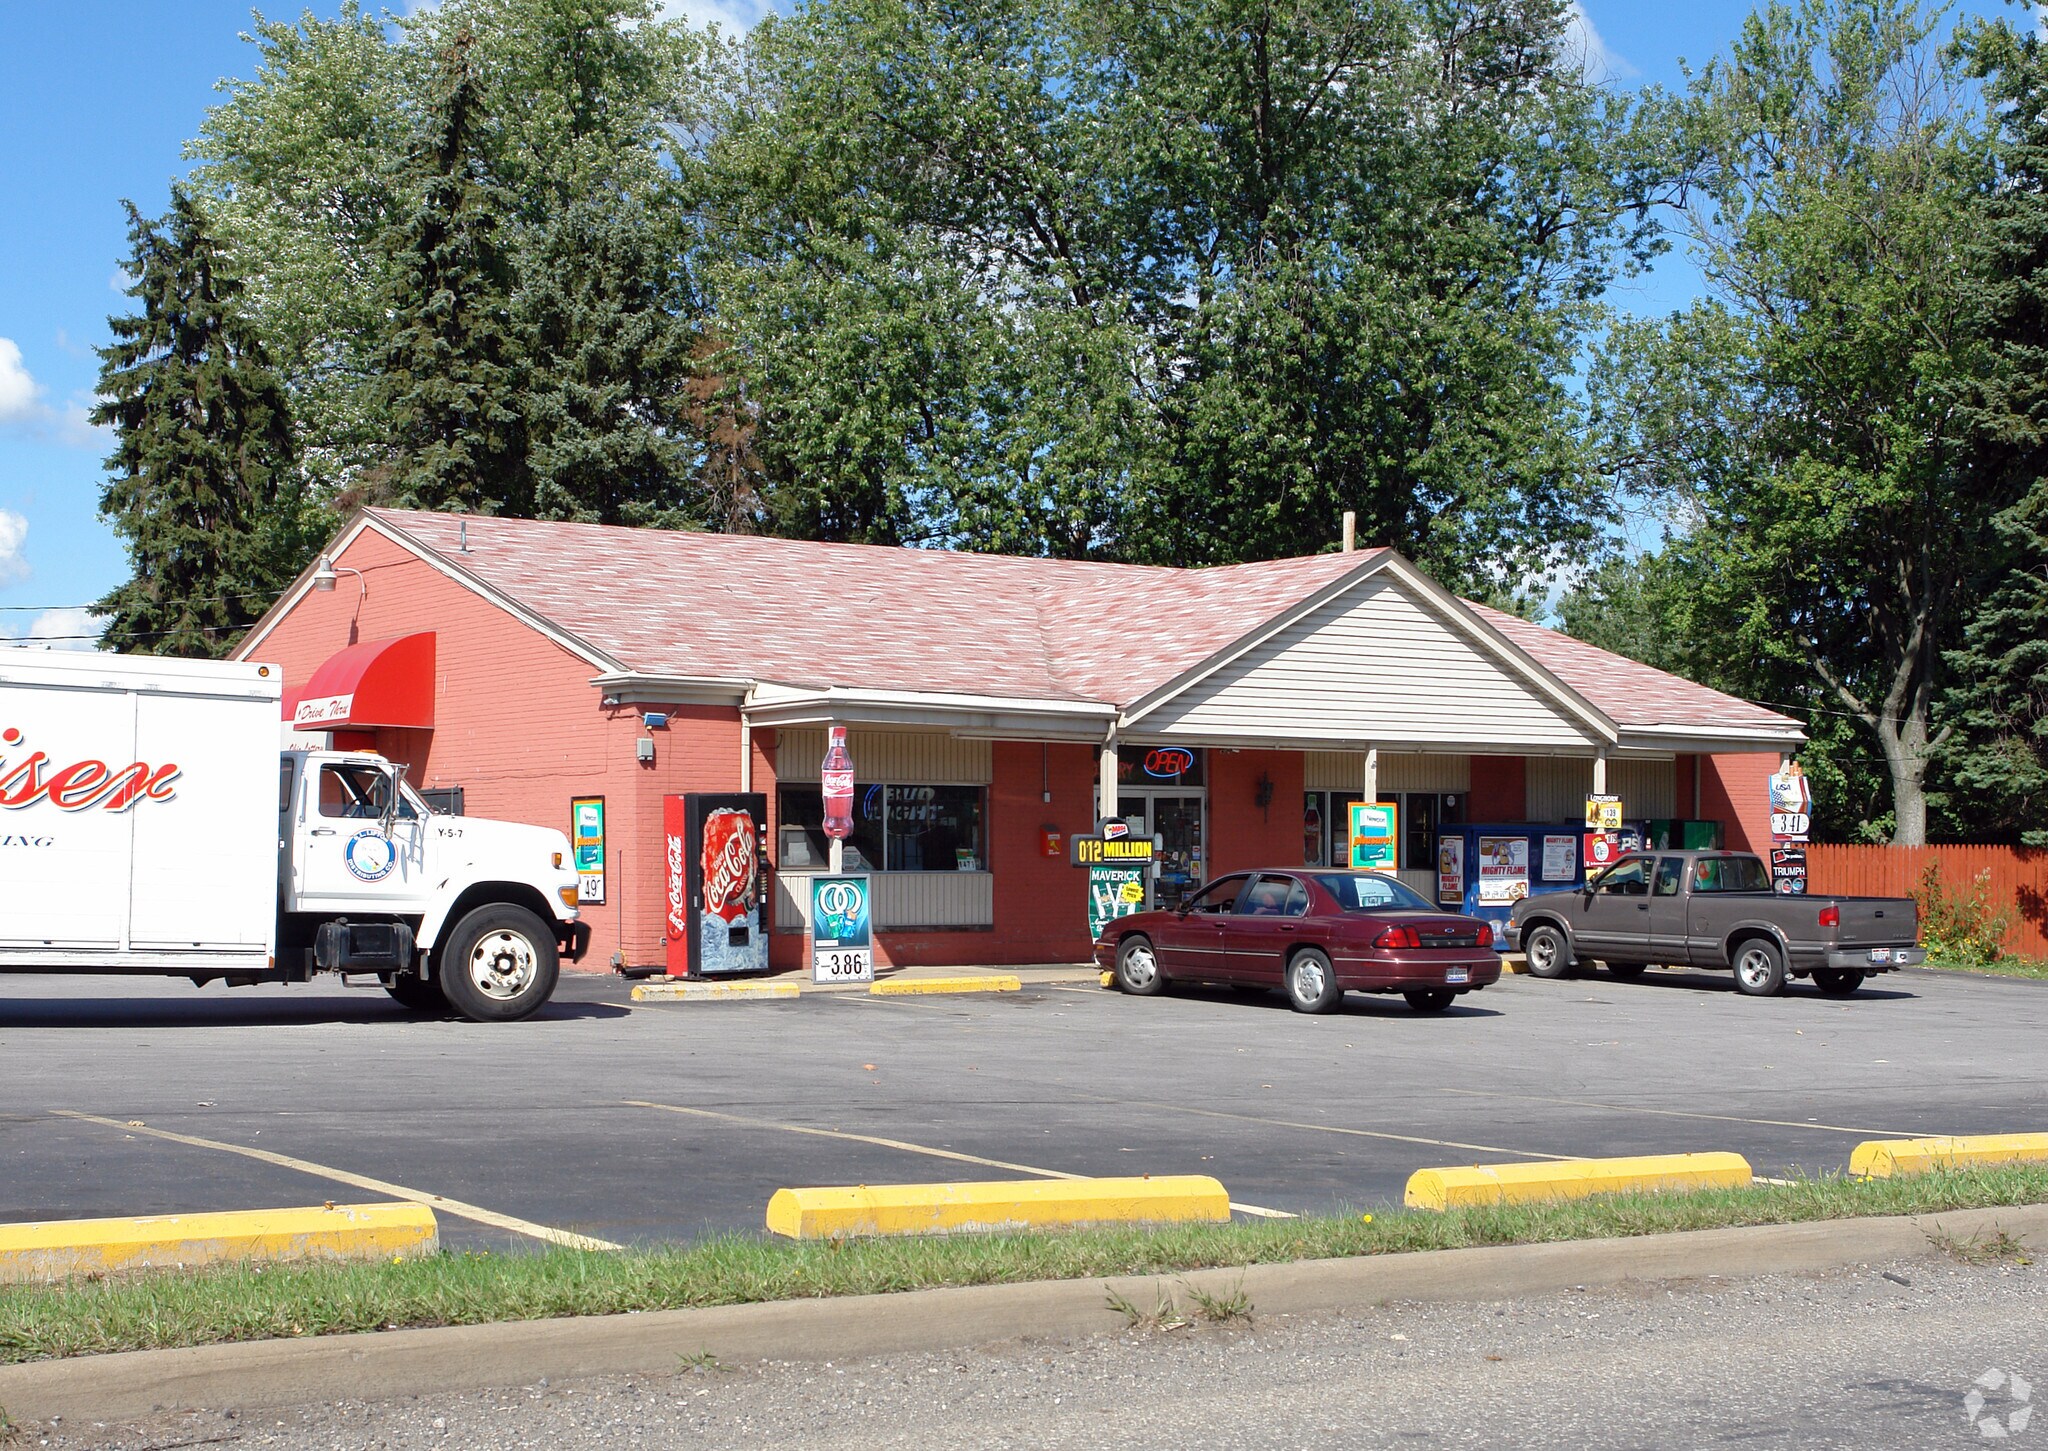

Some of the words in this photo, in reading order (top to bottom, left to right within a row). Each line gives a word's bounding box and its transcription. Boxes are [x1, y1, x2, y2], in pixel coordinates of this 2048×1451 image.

[301, 705, 324, 720] Drive
[1145, 750, 1189, 774] OPEN
[1776, 783, 1791, 791] USA
[1781, 814, 1801, 832] 3.41
[438, 828, 463, 837] Y-5-7
[1079, 841, 1101, 862] 012
[1104, 842, 1152, 857] MILLION
[668, 833, 683, 908] Coca-Cola
[707, 820, 753, 914] Coca-Cola
[1482, 866, 1506, 875] MIGHTY
[1506, 866, 1527, 875] FLAME
[1773, 866, 1805, 876] TRIUMPH
[1092, 871, 1140, 881] MAVERICK
[831, 954, 861, 974] 3.86
